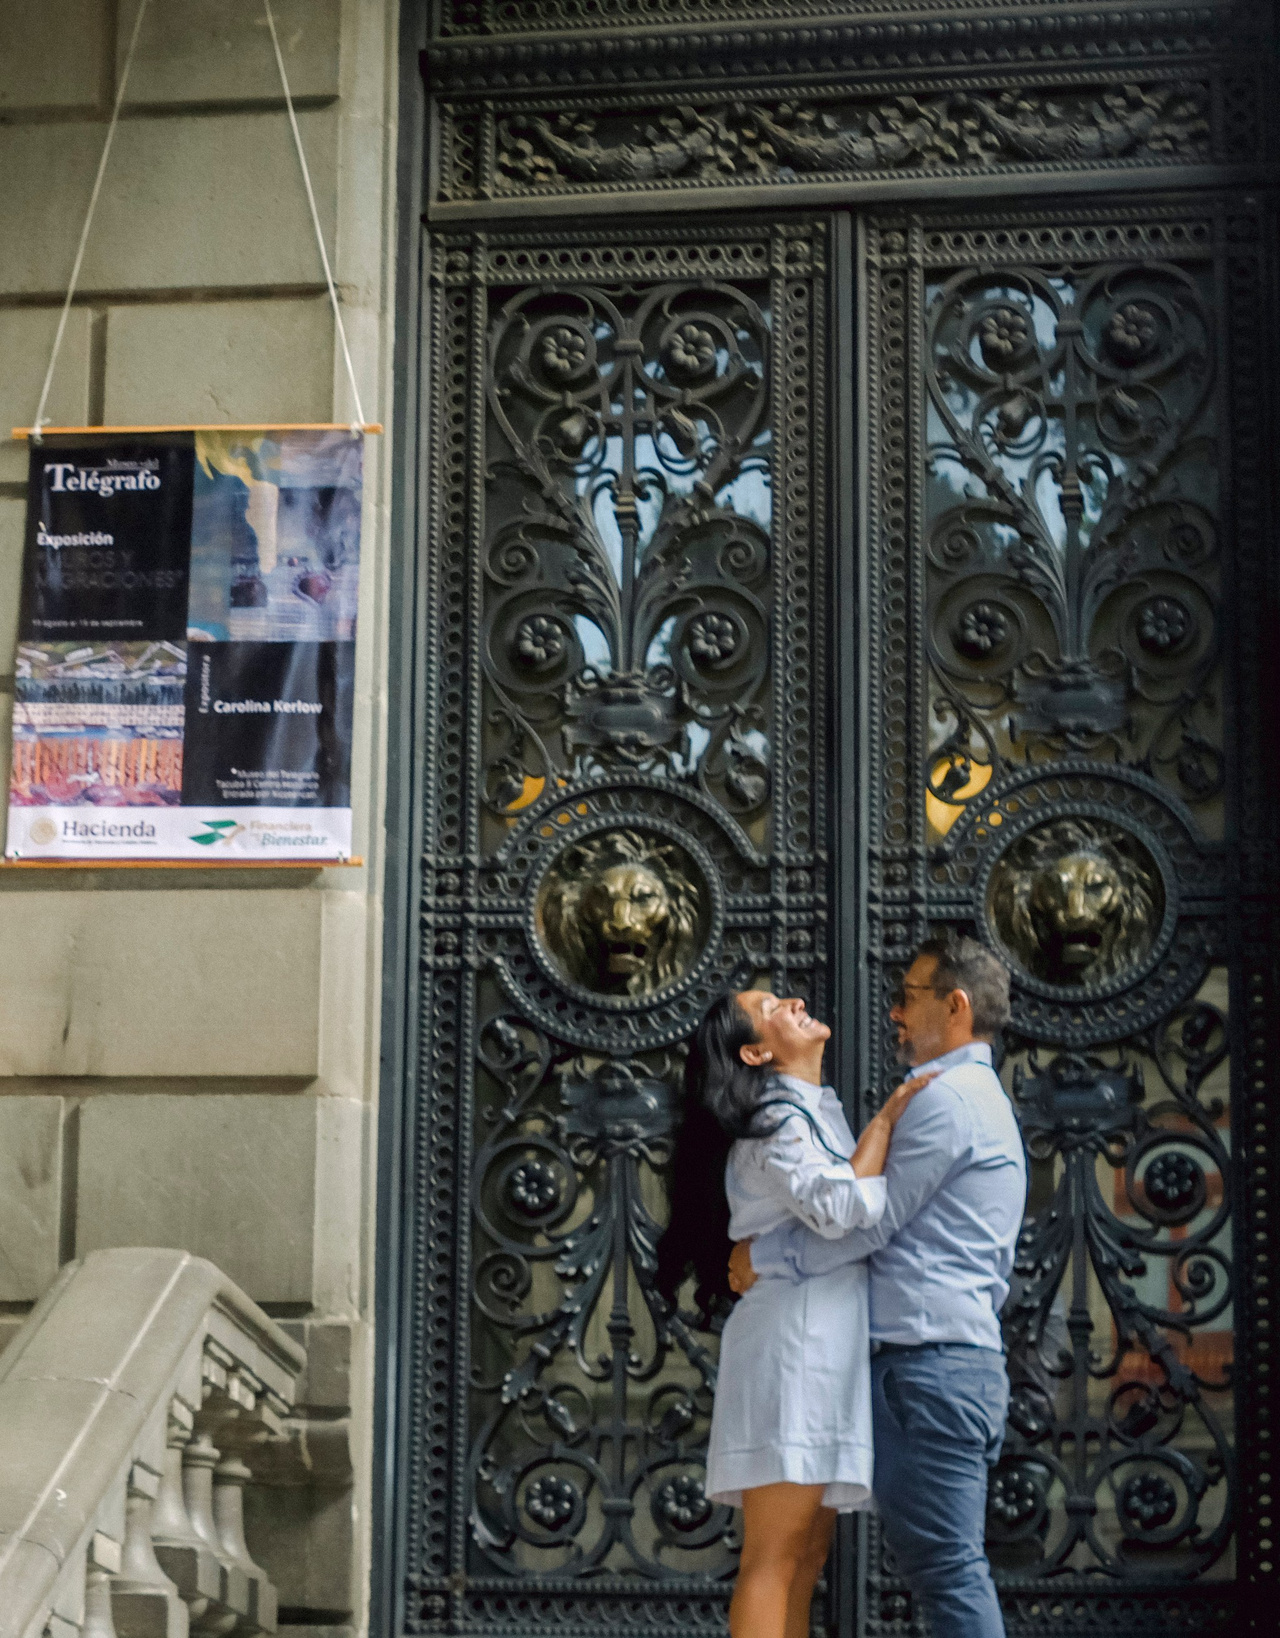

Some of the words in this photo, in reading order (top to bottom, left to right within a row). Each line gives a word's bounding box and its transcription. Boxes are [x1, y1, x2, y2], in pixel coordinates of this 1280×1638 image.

[44, 463, 161, 498] Telégrafo
[36, 531, 114, 549] Exposición
[213, 699, 272, 714] Carolina
[273, 699, 323, 714] Kerlow
[62, 819, 156, 838] Hacienda
[261, 832, 327, 848] Bienestar
